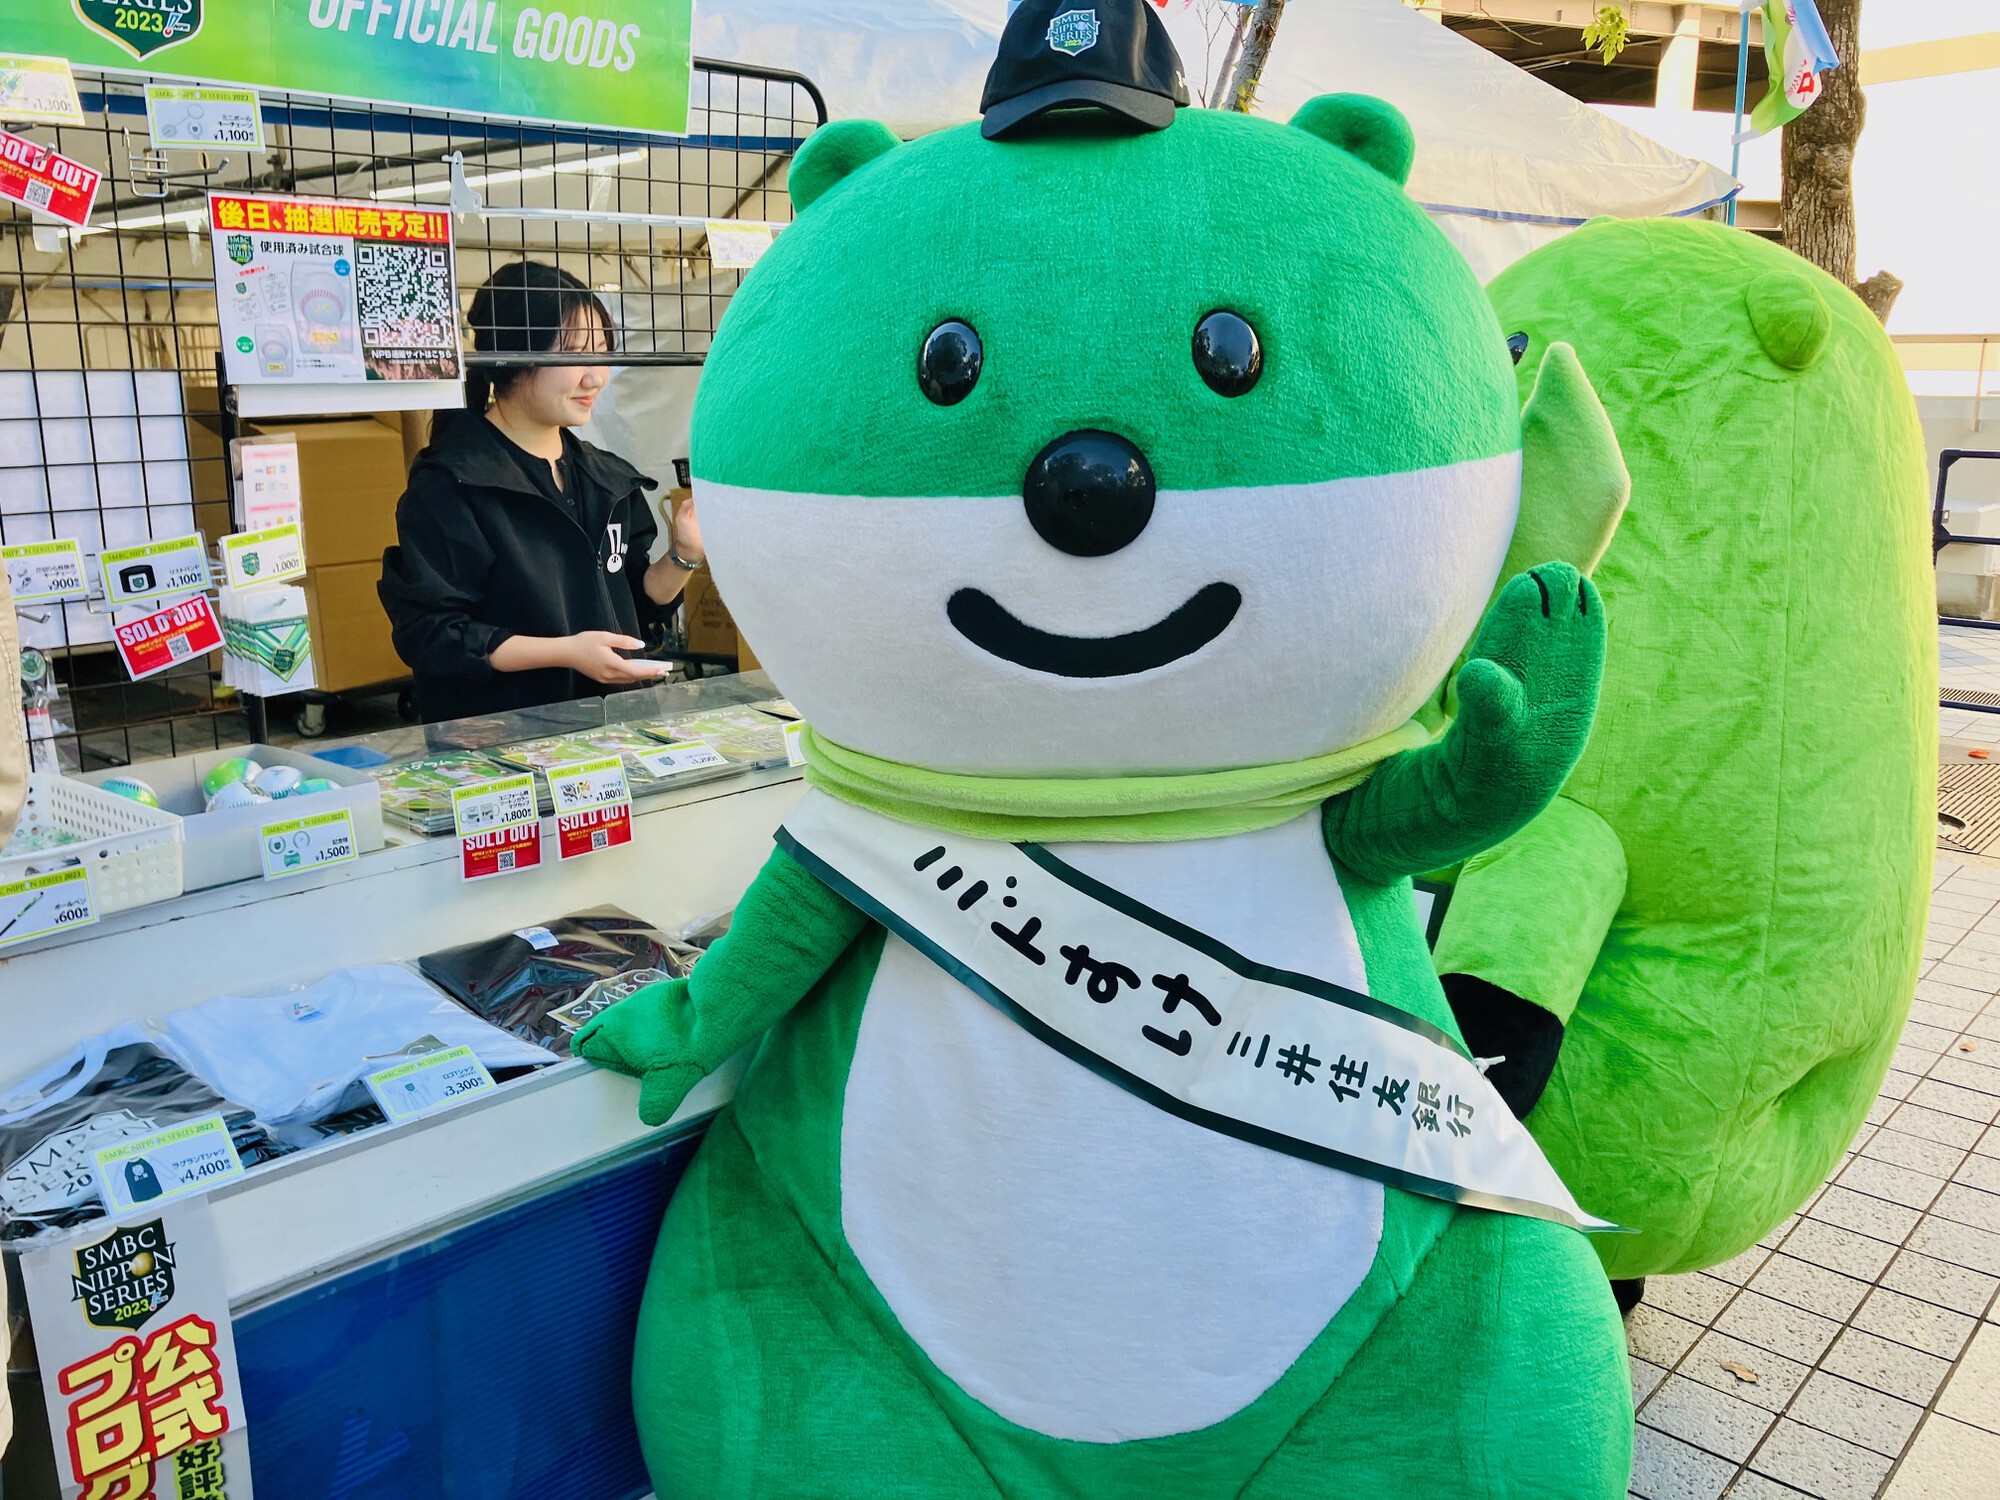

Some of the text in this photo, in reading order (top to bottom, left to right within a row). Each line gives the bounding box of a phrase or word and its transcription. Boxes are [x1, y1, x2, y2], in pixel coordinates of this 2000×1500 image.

[115, 8, 163, 33] 2023
[1049, 21, 1097, 38] NIPPON
[1055, 13, 1090, 26] SMBC
[308, 0, 640, 71] OFFICIAL GOODS
[1054, 30, 1092, 43] SERIES
[232, 94, 249, 102] 2023
[52, 160, 95, 192] OUT
[260, 240, 344, 256] 使用済み試合球
[180, 540, 194, 548] 2023
[48, 577, 74, 591] ¥900
[120, 613, 170, 646] SOLD
[173, 598, 206, 627] OUT
[515, 778, 528, 786] 2023
[331, 812, 344, 820] 2023
[560, 804, 627, 832] SOLD OUT
[465, 823, 538, 851] SOLD OUT
[64, 871, 81, 880] 2023
[54, 907, 82, 924] ¥600
[55, 898, 86, 910] ボールペン
[914, 845, 1222, 1057] ミドすけ
[571, 973, 660, 1019] SMBC
[449, 1049, 464, 1058] 2023
[442, 1066, 474, 1080] ロゴTシャツ
[1227, 1031, 1475, 1138] 三井住友銀行
[443, 1077, 479, 1097] ¥3,300
[104, 1122, 214, 1160] SMBC NIPPON SERIES 2023
[172, 1148, 225, 1170] ラグランTシャツ
[179, 1159, 225, 1184] ¥4,400
[84, 1227, 157, 1270] SMBC
[71, 1241, 176, 1302] NIPPON
[89, 1270, 168, 1316] SERIES
[114, 1298, 150, 1322] 2023
[142, 1320, 223, 1457] 公式
[176, 1441, 219, 1500] 好評
